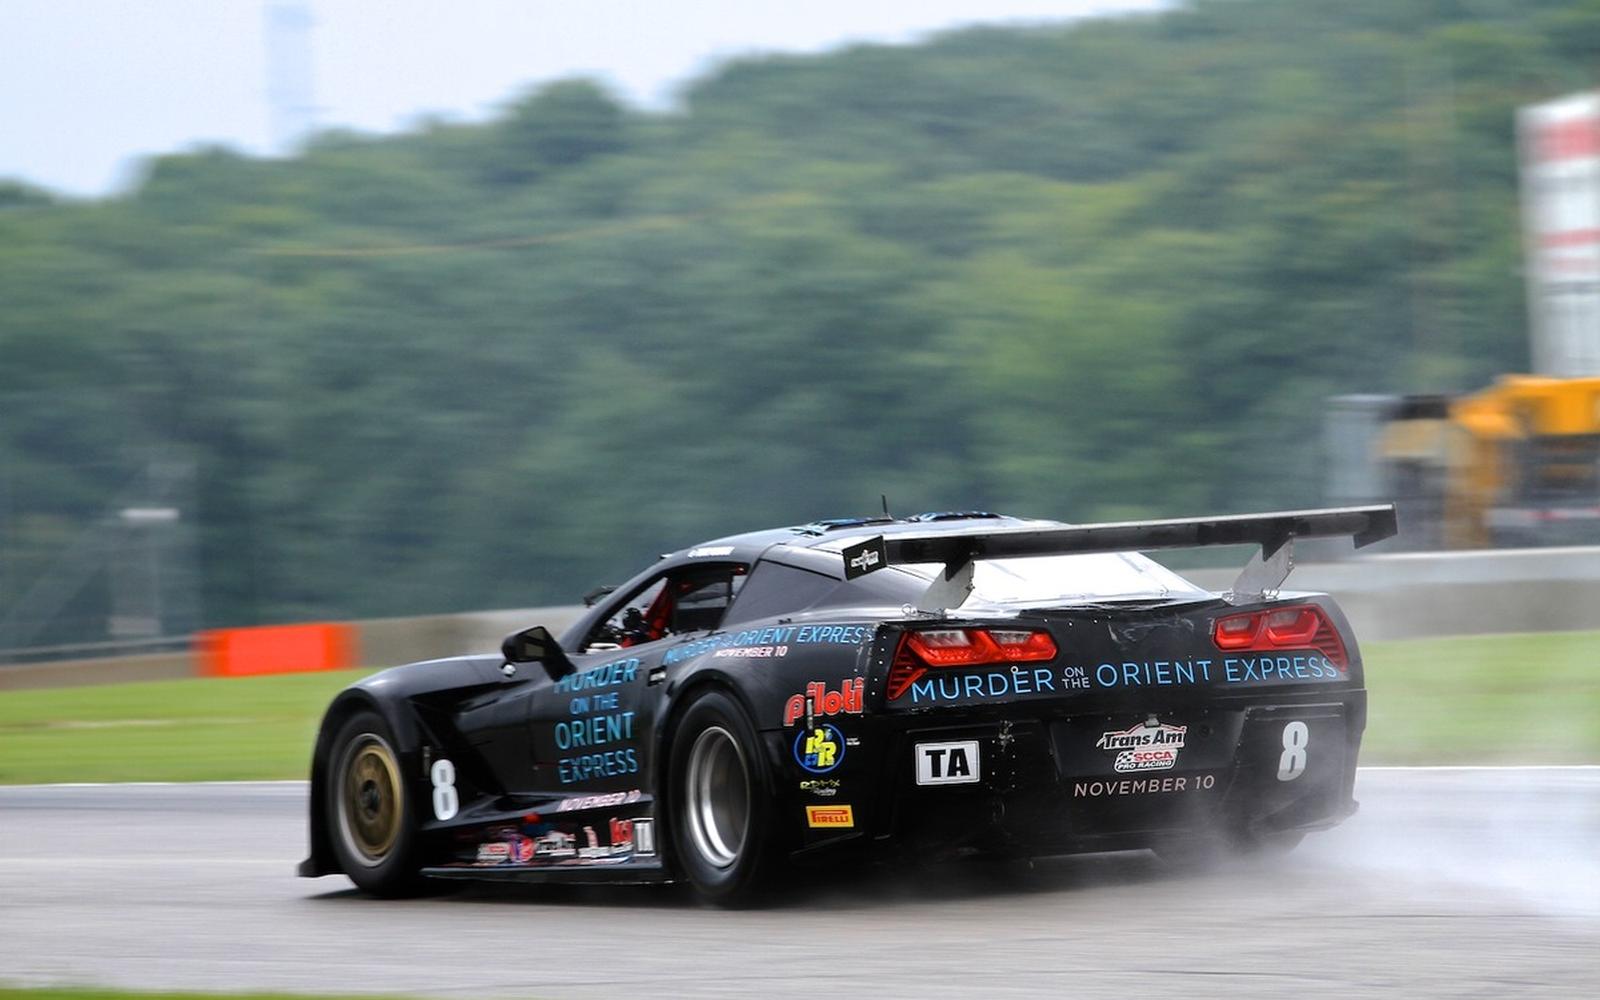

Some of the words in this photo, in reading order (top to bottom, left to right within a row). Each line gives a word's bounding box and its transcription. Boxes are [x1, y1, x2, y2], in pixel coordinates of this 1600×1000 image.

[733, 627, 797, 646] ORIENT
[774, 646, 788, 657] 10
[554, 658, 640, 693] MURDER
[1063, 666, 1085, 678] ON
[1095, 660, 1212, 688] ORIENT
[1225, 656, 1338, 682] EXPRESS
[912, 668, 1055, 703] MURDER
[1062, 675, 1089, 689] THE
[570, 698, 589, 714] ON
[593, 692, 619, 711] THE
[555, 712, 634, 749] ORIENT
[1104, 733, 1150, 748] Trans
[1153, 729, 1182, 745] Am
[1134, 751, 1173, 762] SCCA
[1277, 721, 1309, 782] 8
[559, 749, 638, 783] EXPRESS
[925, 748, 970, 778] TA
[1117, 762, 1136, 770] PRO
[1138, 760, 1172, 769] RACING
[431, 759, 459, 820] 8
[1074, 777, 1186, 797] NOVEMBER
[1196, 775, 1215, 789] 10
[811, 810, 848, 823] PIRELLI
